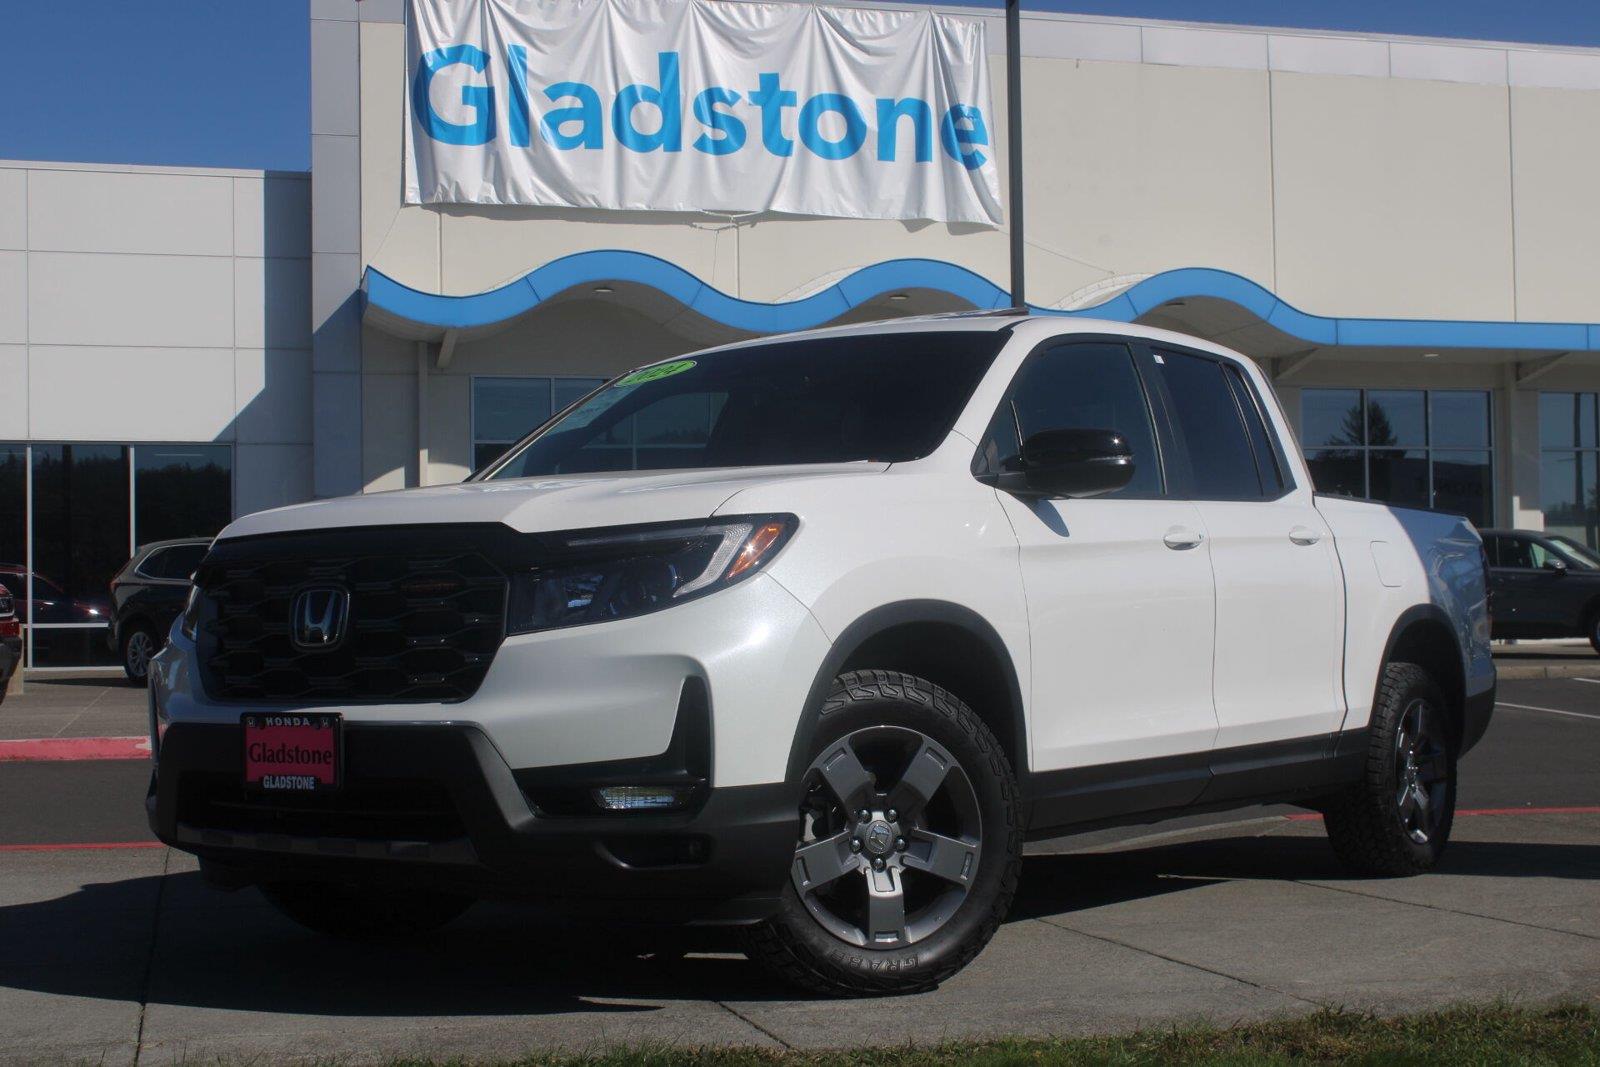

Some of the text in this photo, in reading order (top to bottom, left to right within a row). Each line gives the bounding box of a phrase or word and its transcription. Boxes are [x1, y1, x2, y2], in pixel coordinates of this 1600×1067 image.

[412, 44, 990, 170] Gladstone
[266, 717, 310, 726] HONDA
[249, 742, 332, 765] Gladstone
[263, 775, 315, 790] GLADSTONE
